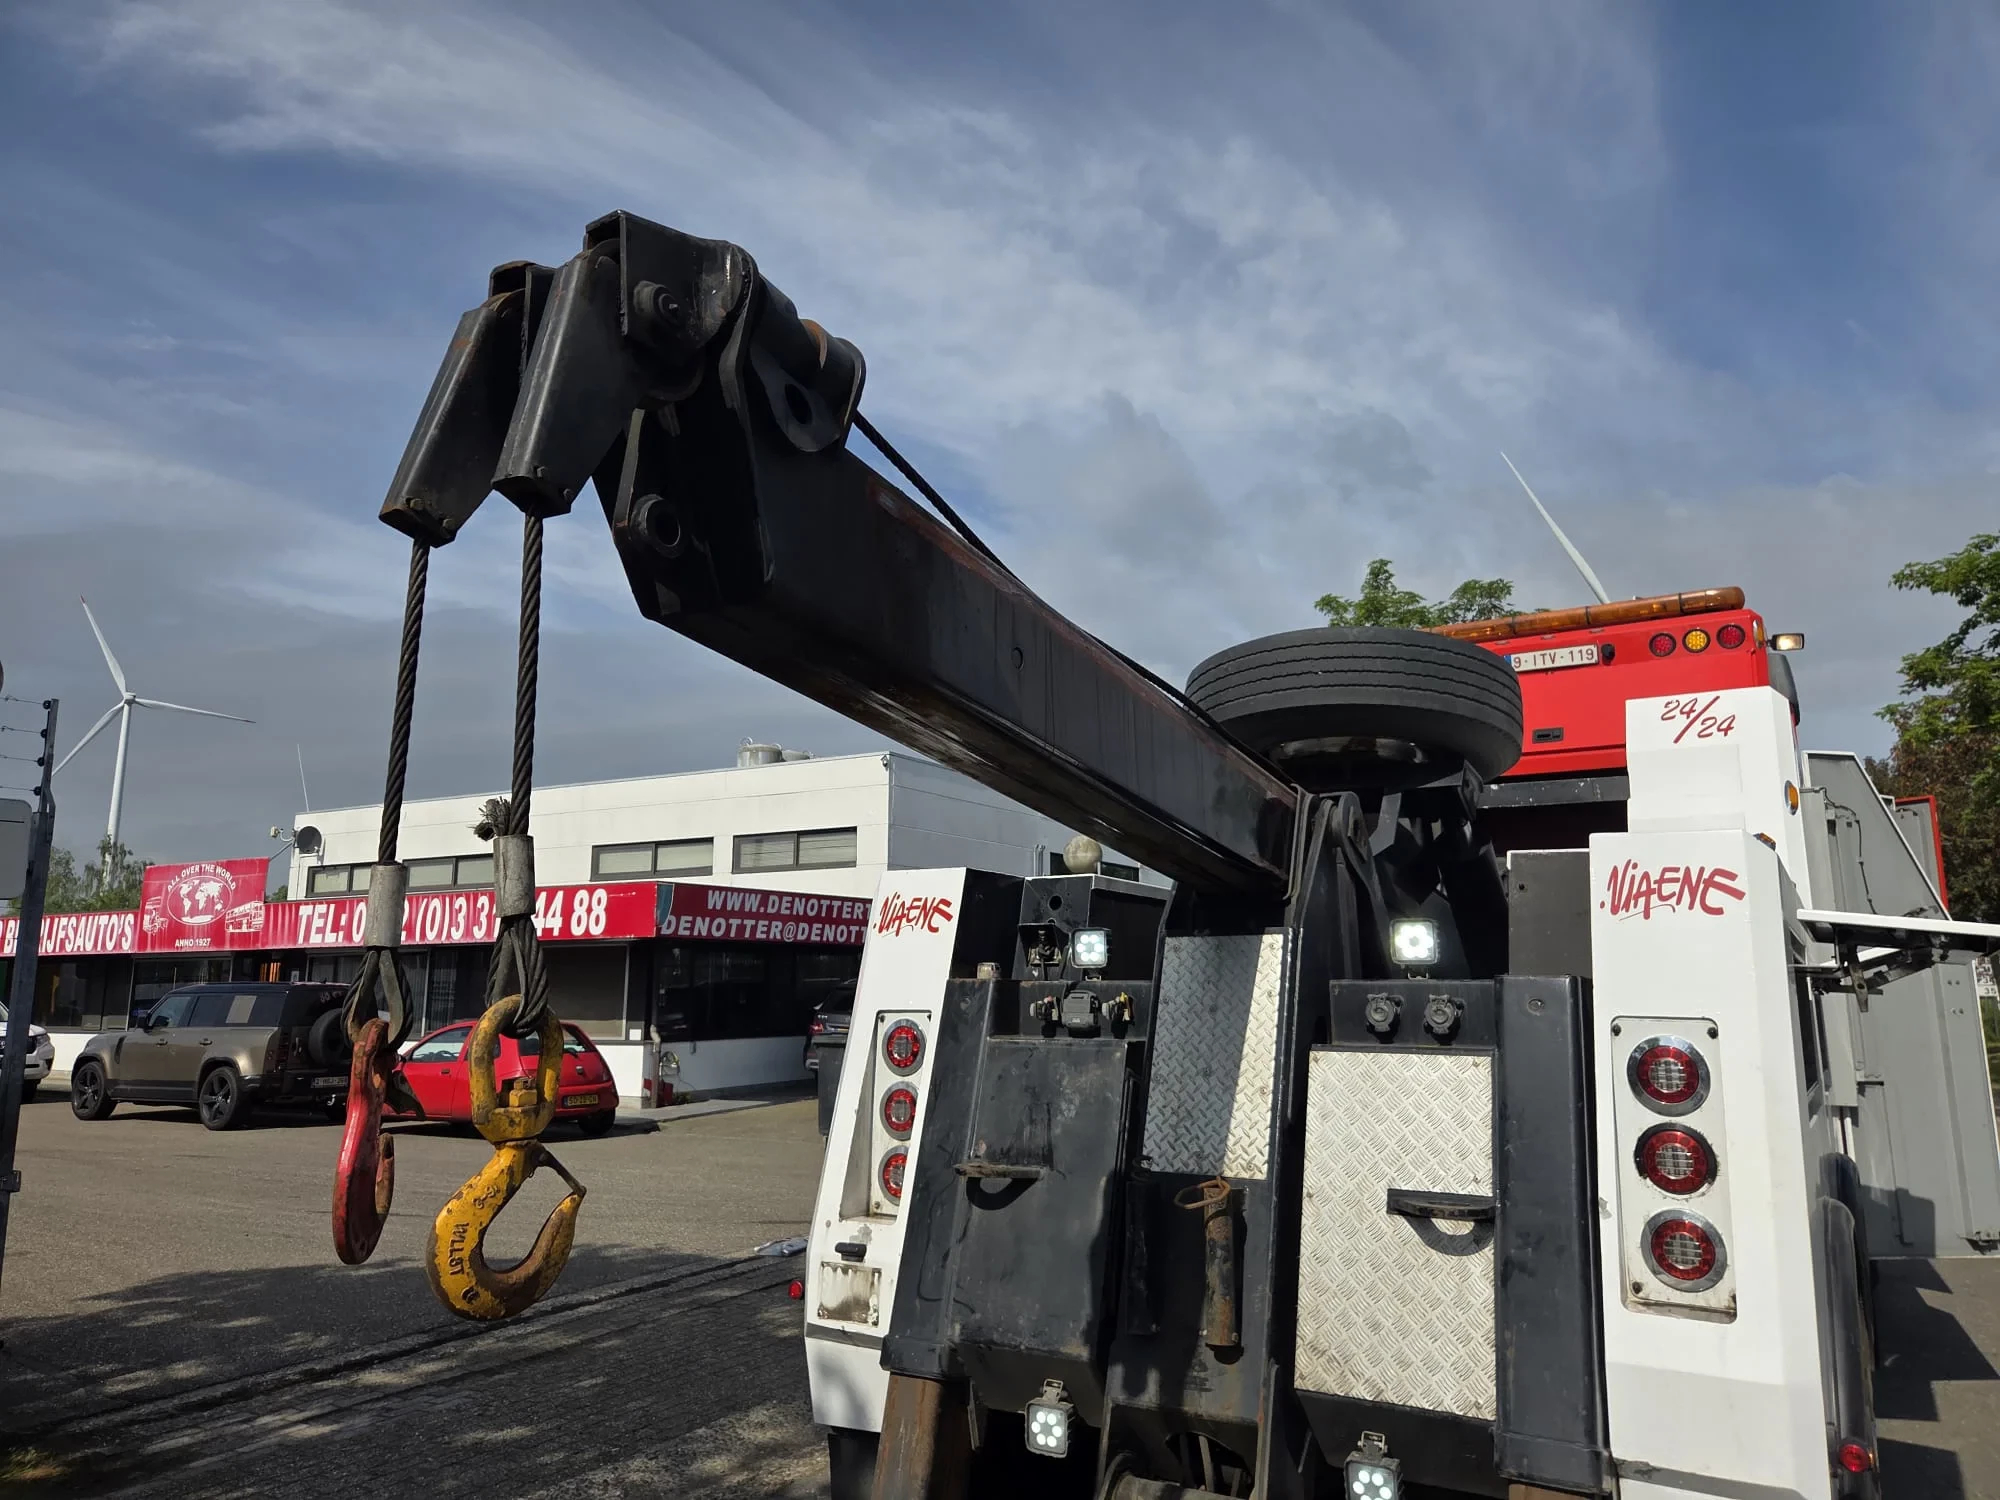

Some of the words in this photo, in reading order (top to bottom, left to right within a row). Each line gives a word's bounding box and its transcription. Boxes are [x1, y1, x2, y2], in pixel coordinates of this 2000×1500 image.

[1660, 695, 1736, 744] 24/24
[167, 875, 180, 892] ALL
[181, 864, 200, 878] OVER
[201, 864, 215, 873] THE
[216, 865, 236, 890] WORLD
[298, 903, 348, 944] TEL:
[570, 888, 608, 936] 88
[175, 939, 194, 947] ANNO
[195, 938, 212, 947] 1927
